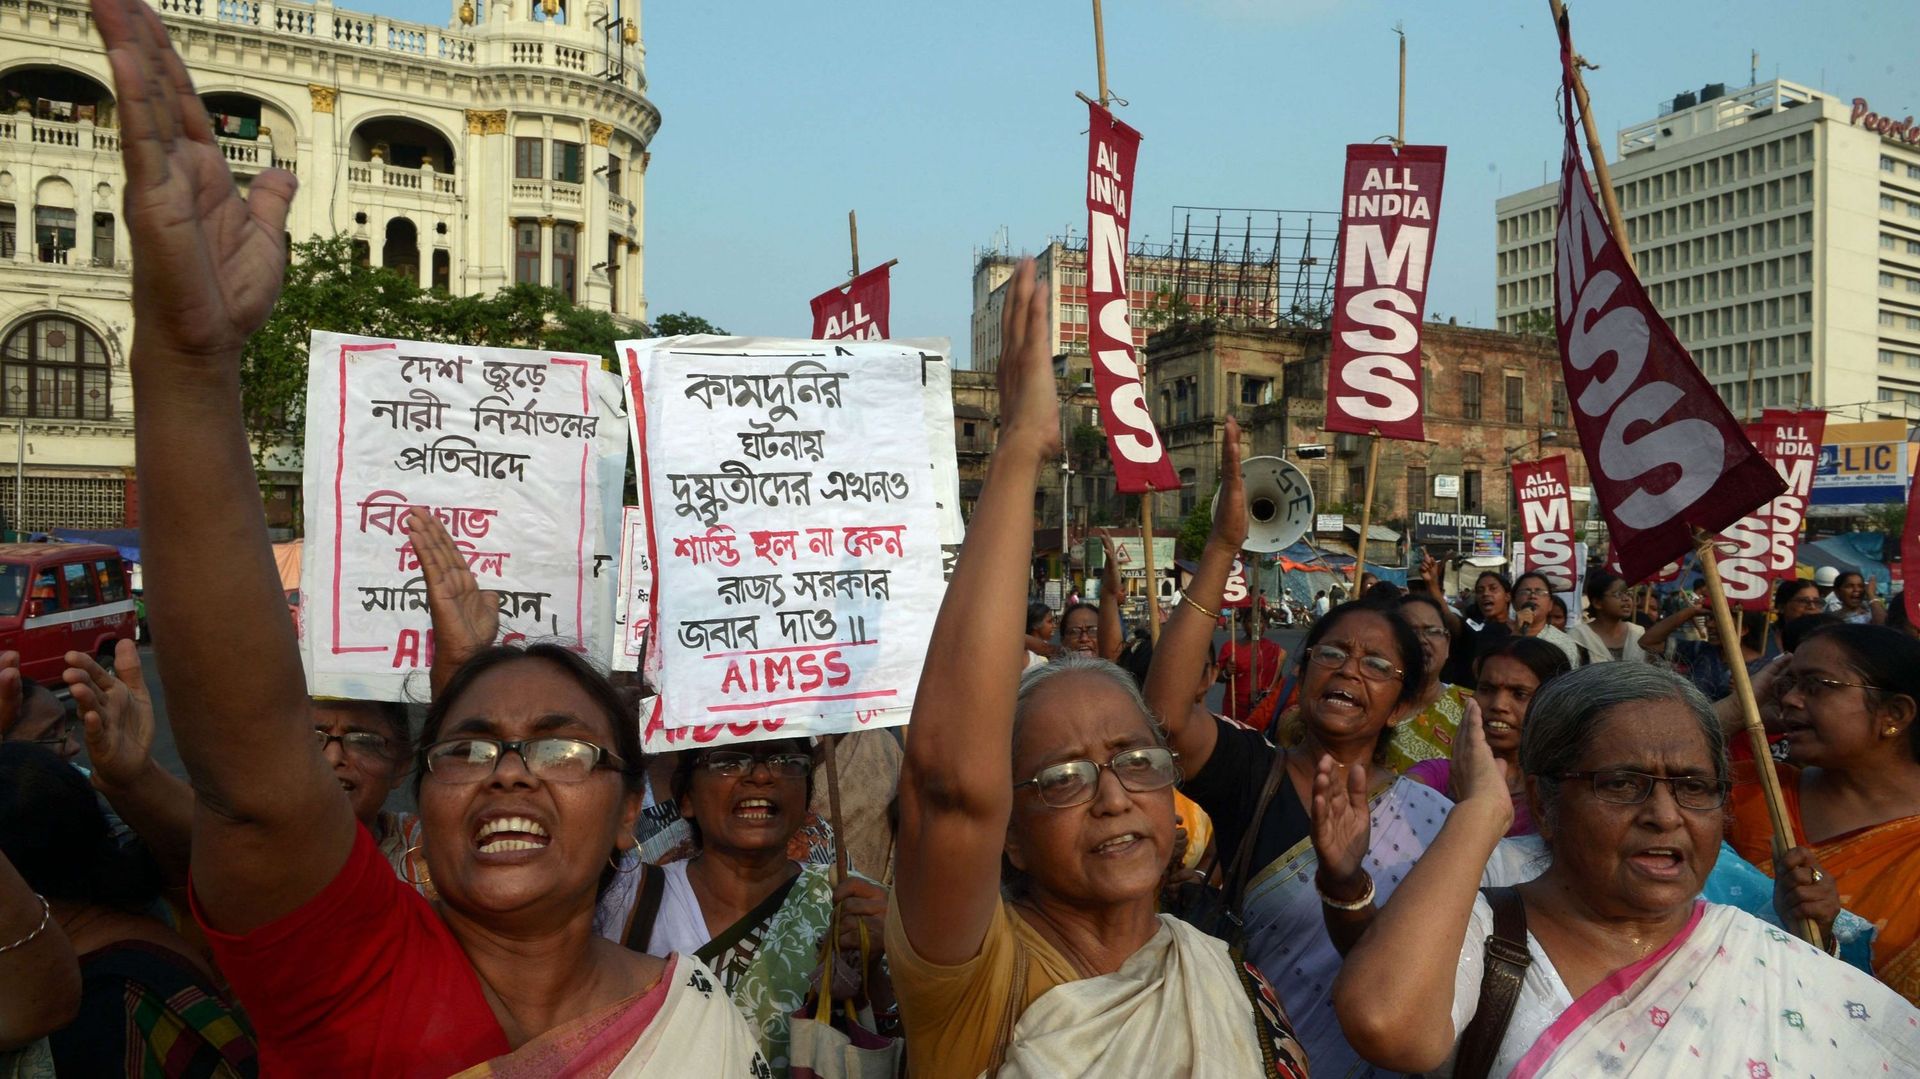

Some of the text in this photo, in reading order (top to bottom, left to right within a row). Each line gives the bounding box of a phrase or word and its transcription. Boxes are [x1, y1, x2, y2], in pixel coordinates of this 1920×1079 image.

[1096, 141, 1122, 182] AL
[1361, 167, 1419, 192] ALL
[1347, 193, 1432, 220] INDIA
[822, 302, 871, 340] ALL
[1335, 224, 1430, 422] MSS
[399, 355, 547, 401] দেশ জুড়ে
[684, 360, 849, 421] কামদুনির
[371, 388, 600, 440] নারী নির্যাতনের
[737, 418, 825, 463] ঘটনায়
[1775, 442, 1815, 457] NDIA
[1776, 426, 1808, 441] ALL
[394, 435, 531, 483] প্রতিবাদে
[1845, 445, 1891, 471] LIC
[820, 468, 910, 505] এখনও
[1520, 483, 1566, 500] INDIA
[1525, 471, 1557, 487] ALL
[1418, 511, 1487, 528] UTTAM TEXTILE
[673, 524, 741, 568] শাস্তি
[750, 528, 800, 567] হল
[806, 526, 834, 558] না
[842, 523, 907, 559] কেন
[357, 576, 431, 614] সামি
[717, 569, 891, 608] রাজ্য সরকার
[677, 614, 760, 651] জবাব
[720, 649, 852, 695] AIMSS
